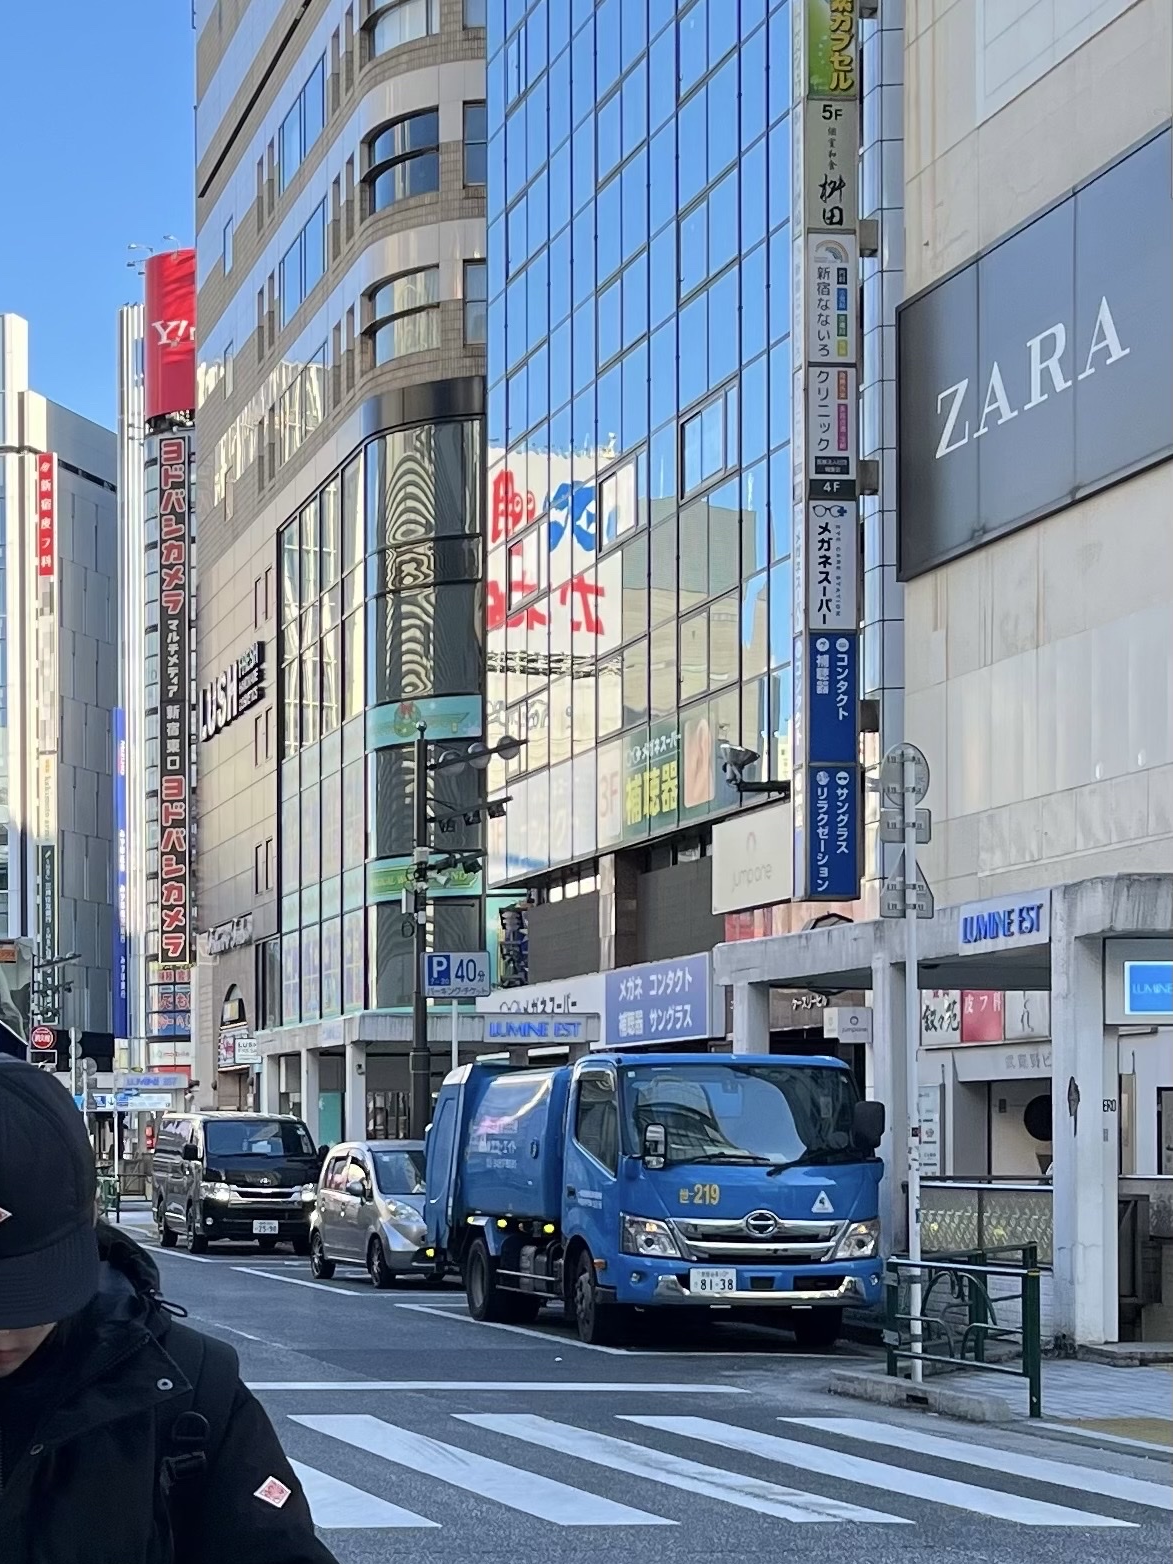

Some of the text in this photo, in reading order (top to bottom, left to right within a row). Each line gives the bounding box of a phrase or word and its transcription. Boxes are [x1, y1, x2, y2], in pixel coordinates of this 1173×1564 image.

[822, 104, 843, 120] 5F
[817, 267, 831, 357] 新宿なないろ
[934, 296, 1131, 459] ZARA
[817, 371, 831, 451] クリニック
[823, 482, 841, 493] 4F
[161, 440, 185, 616] ヨドバシカメラ
[817, 522, 833, 625] メガネスーパー
[166, 619, 180, 698] マルチメディア
[836, 654, 848, 720] コンタクト
[199, 660, 238, 742] LUSH
[166, 704, 180, 770] 新宿東口
[625, 760, 679, 826] 補聴器
[836, 787, 849, 854] サングラス
[161, 775, 186, 957] ヨドバシカメラ
[816, 787, 829, 892] リラクゼーション
[962, 904, 1043, 943] LUMINE EST
[433, 956, 447, 978] P
[619, 967, 693, 1002] メガネ コンタクト
[489, 1021, 582, 1037] LUMINE EST
[649, 1004, 693, 1033] サングラス
